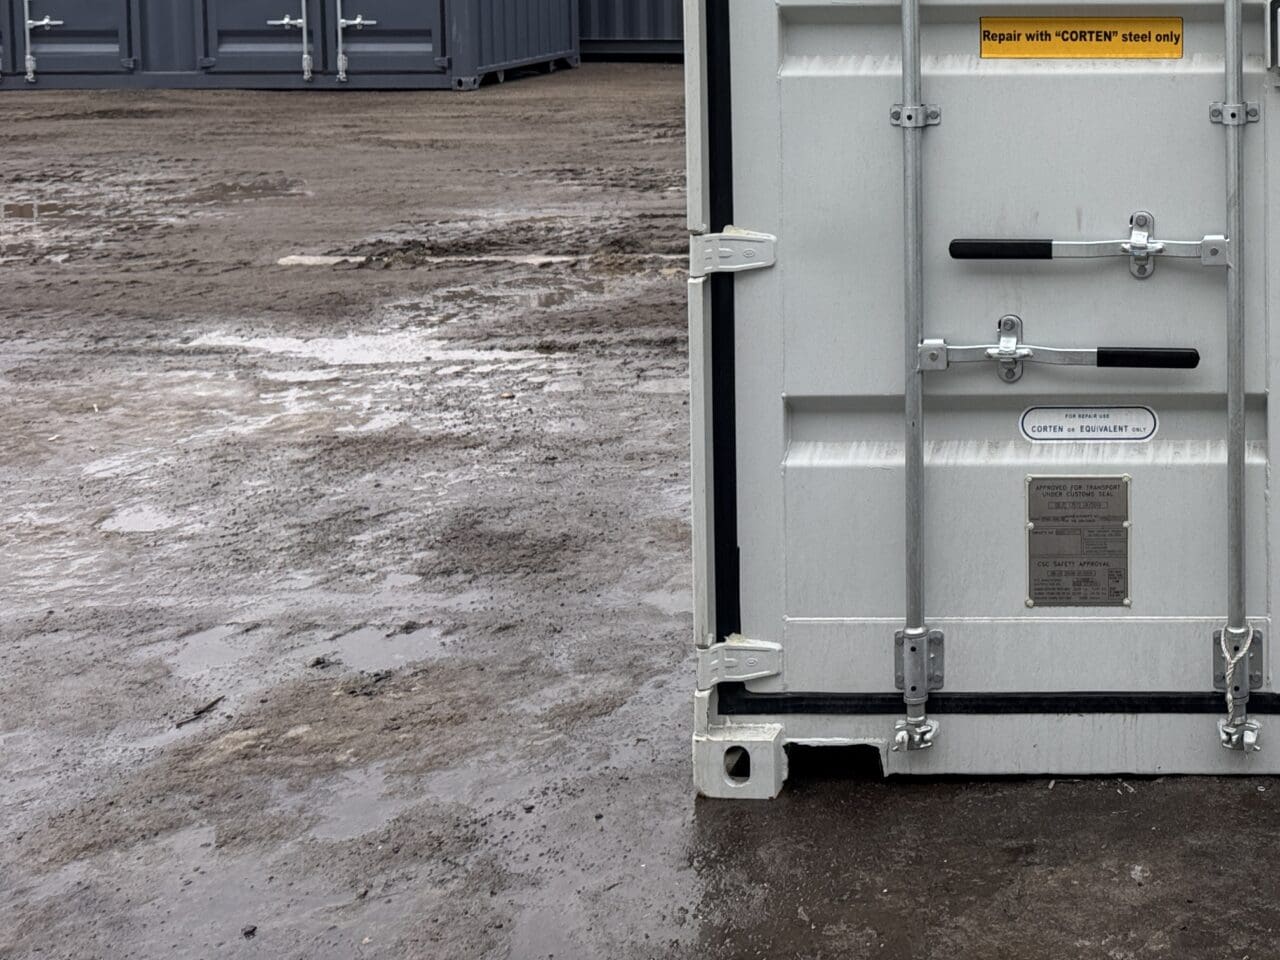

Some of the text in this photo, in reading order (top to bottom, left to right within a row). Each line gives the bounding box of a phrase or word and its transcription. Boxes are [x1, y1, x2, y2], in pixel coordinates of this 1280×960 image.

[983, 30, 1022, 44] Repair
[1025, 30, 1051, 42] with
[1121, 30, 1151, 43] steel
[1155, 31, 1181, 45] only
